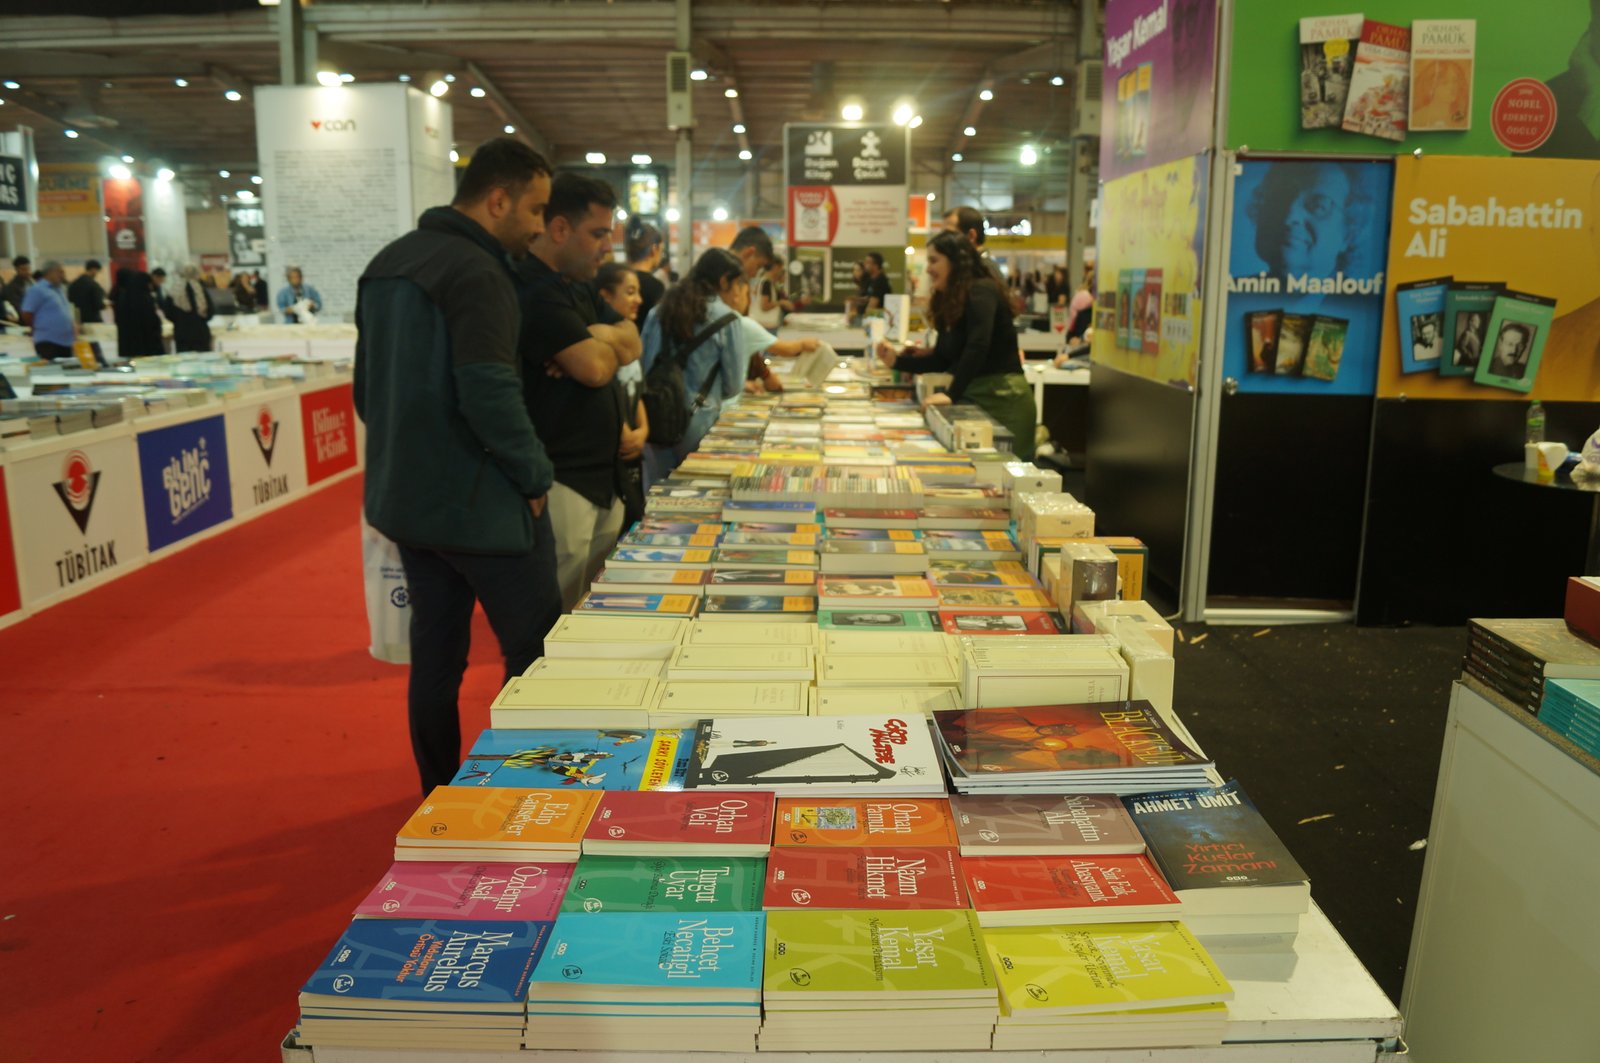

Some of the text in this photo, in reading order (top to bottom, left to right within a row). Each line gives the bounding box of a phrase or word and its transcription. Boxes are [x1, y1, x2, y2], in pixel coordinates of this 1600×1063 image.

[1133, 0, 1168, 49] Kemal
[1310, 27, 1355, 40] PAMUK
[1421, 33, 1466, 44] PAMUK
[1427, 24, 1460, 33] ORHAN
[1369, 34, 1411, 50] PAMU
[1508, 99, 1540, 109] NOBEL
[324, 119, 356, 132] can
[1409, 195, 1583, 230] Sabahattin
[1404, 229, 1447, 258] Ali
[1227, 273, 1281, 295] Amin
[1286, 272, 1384, 295] Maalouf
[252, 474, 288, 506] TÜBİTAK
[55, 538, 117, 587] TÜBİTAK
[647, 740, 671, 786] ŞARKI SÖYLEYEN
[506, 792, 552, 836] Cansever
[529, 803, 569, 825] Edip
[688, 806, 719, 826] Veli
[714, 799, 748, 833] Orhan
[866, 803, 896, 834] Pamuk
[892, 804, 922, 833] Orhan
[1043, 811, 1075, 825] Ali
[1063, 795, 1109, 842] Sabahattin
[1133, 790, 1242, 815] AHMET ÜMİT
[1183, 860, 1277, 875] Zamanı
[1187, 851, 1256, 864] Kuşlar
[469, 876, 507, 902] Asaf
[494, 866, 548, 912] Özdemir
[659, 870, 700, 900] Uyar
[687, 867, 730, 903] Turgut
[865, 856, 898, 898] Hikmet
[896, 858, 927, 895] Nâzım
[1070, 860, 1118, 902] Abasıyanık
[1107, 881, 1136, 896] Faik
[395, 934, 436, 983] Örtüsü Yoktur
[415, 940, 445, 976] Yıldızların
[423, 931, 481, 992] Aurelius
[457, 931, 514, 988] Marcus
[658, 920, 708, 978] Necatigil
[694, 927, 734, 972] Behçet
[878, 927, 917, 970] Kemal
[905, 928, 945, 967] Yaşar
[1093, 935, 1148, 980] Kemal
[1127, 934, 1168, 974] Yaşar
